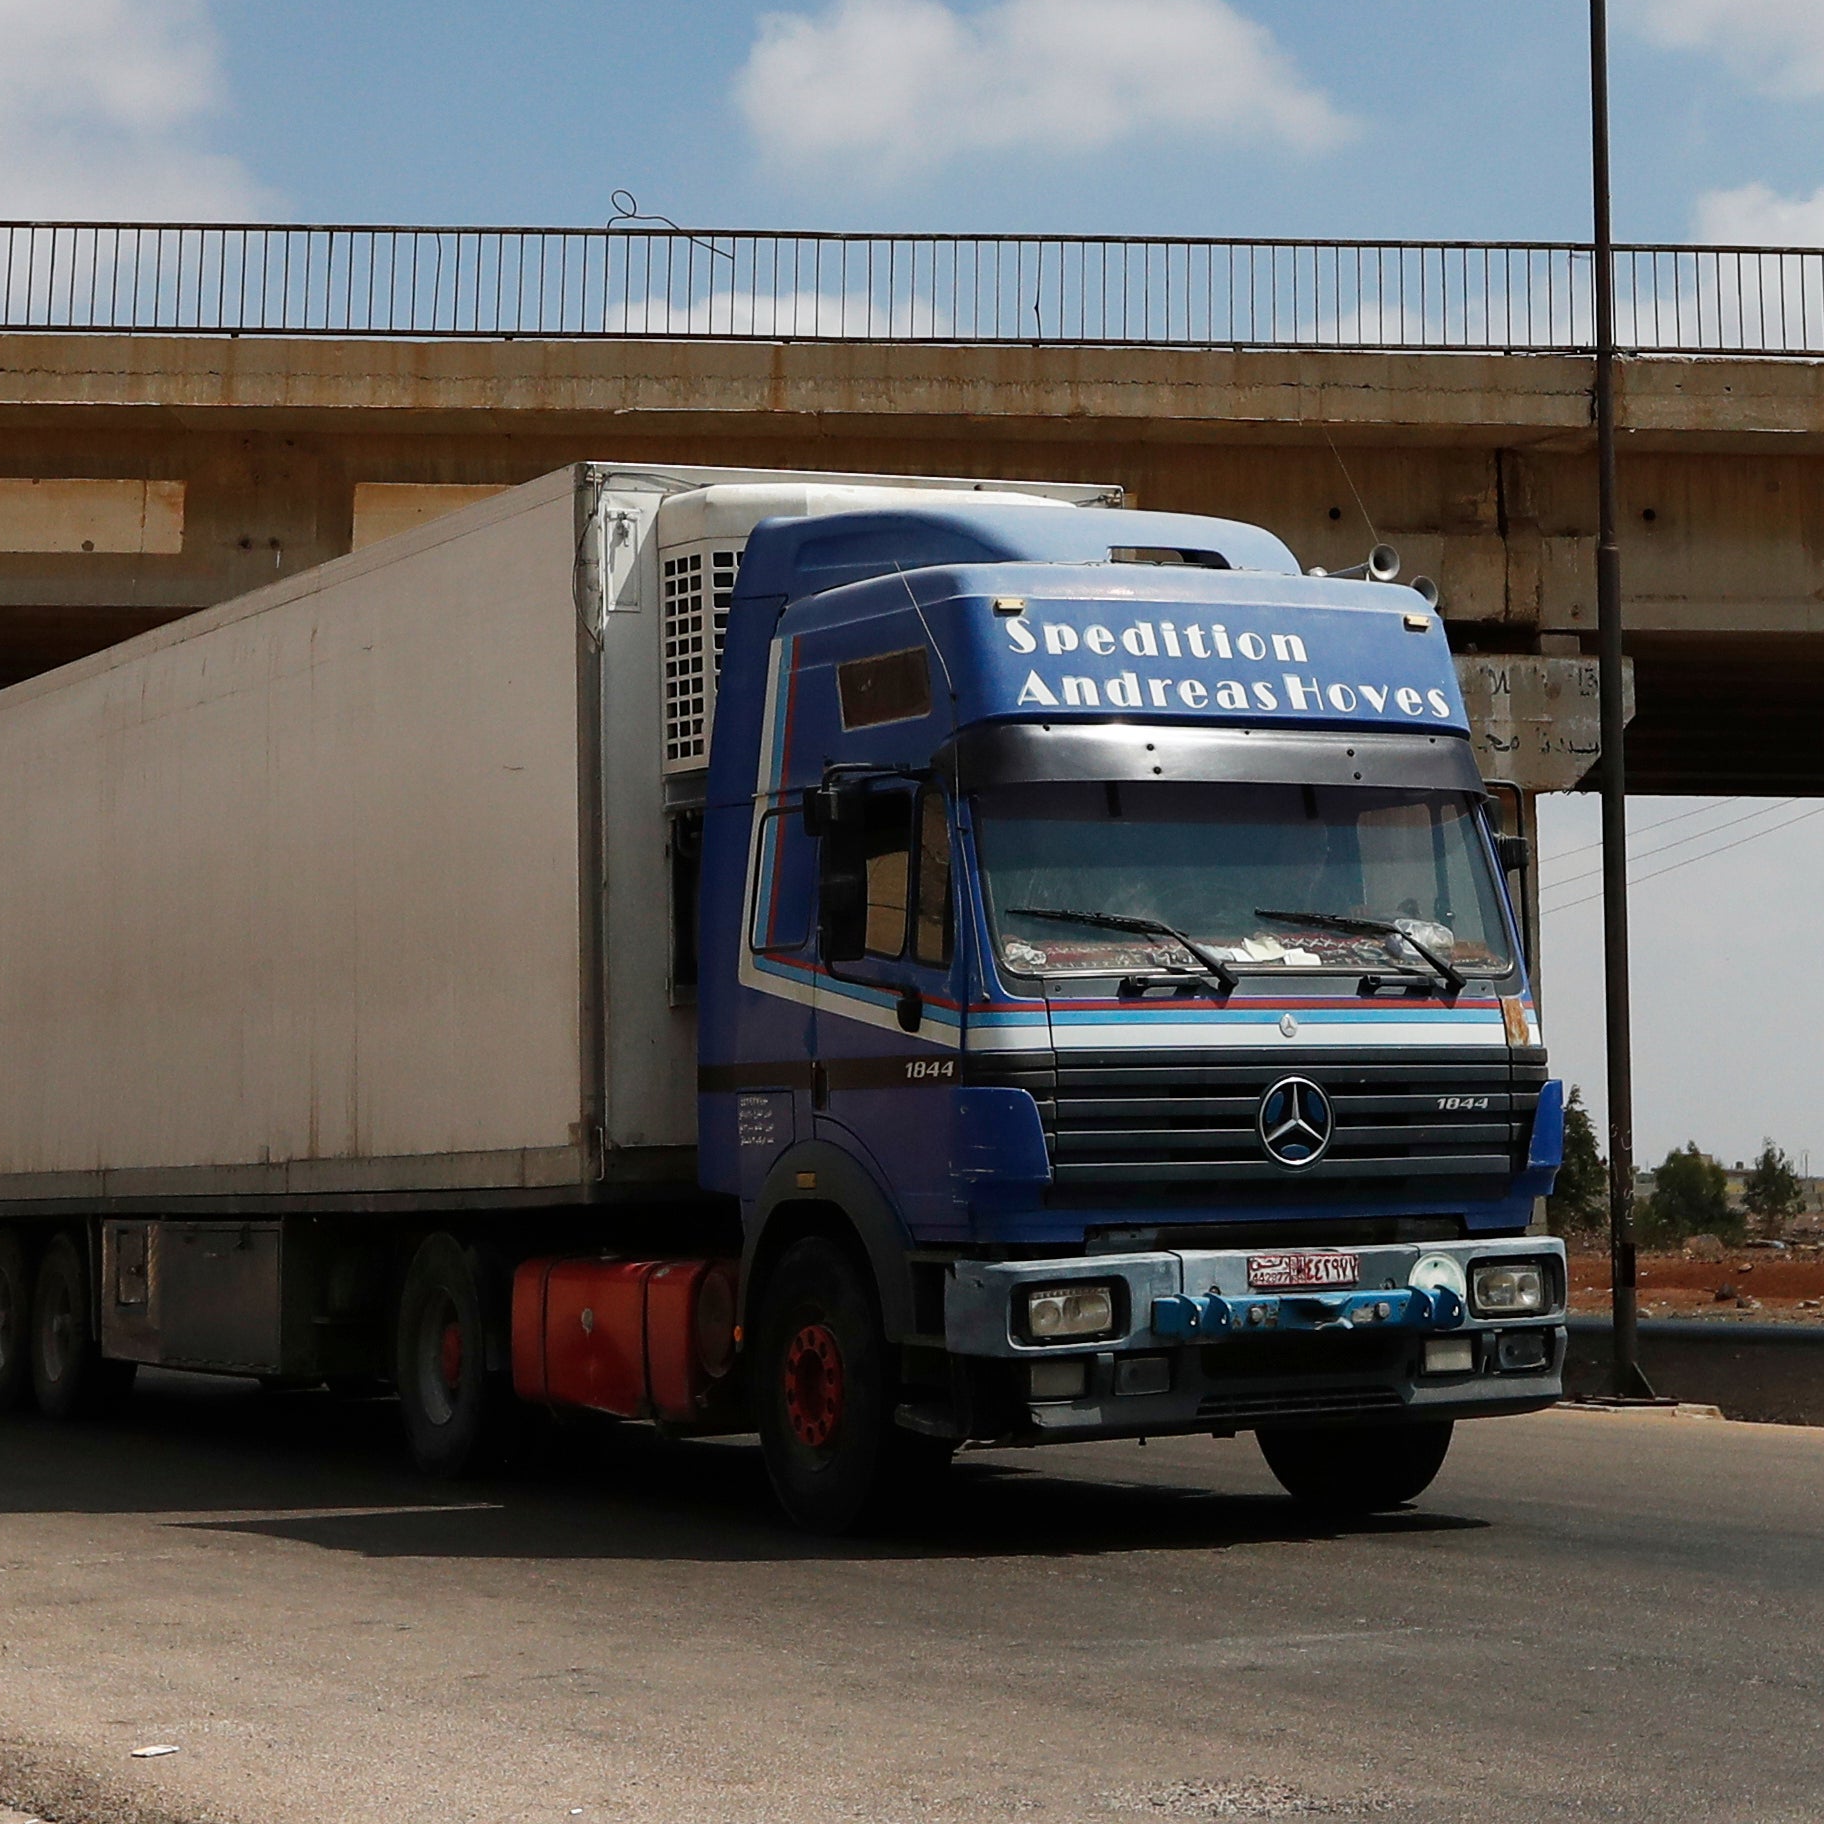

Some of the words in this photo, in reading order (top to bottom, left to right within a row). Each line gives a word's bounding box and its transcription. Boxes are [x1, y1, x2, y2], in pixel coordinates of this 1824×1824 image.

[1004, 616, 1308, 663] Spedition
[905, 1060, 954, 1078] 1844
[1437, 1097, 1488, 1110] 1844
